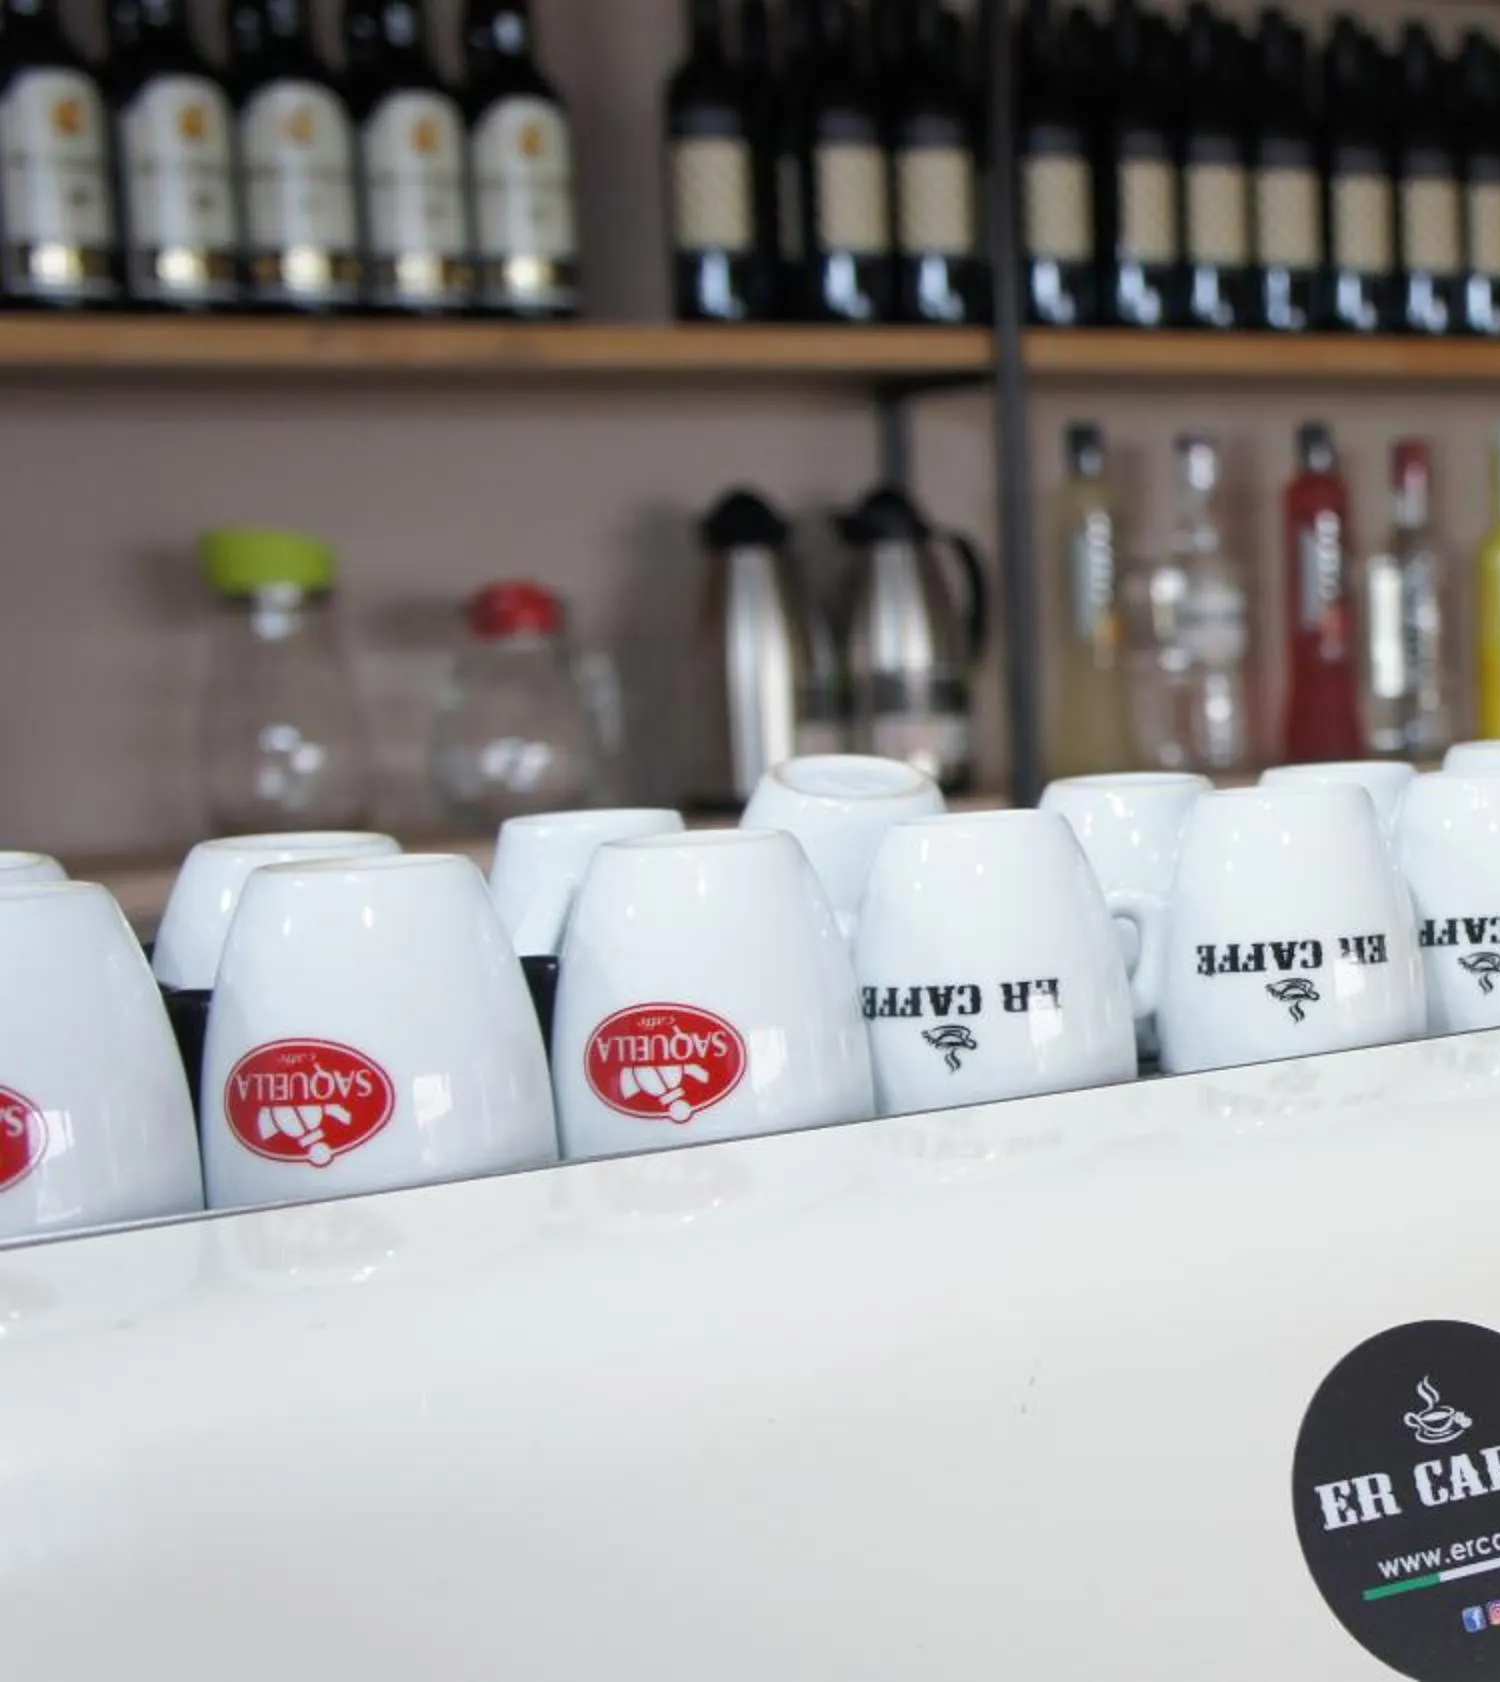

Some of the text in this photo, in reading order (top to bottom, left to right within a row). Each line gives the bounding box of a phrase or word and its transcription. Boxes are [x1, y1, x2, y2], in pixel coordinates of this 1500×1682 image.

[597, 1025, 729, 1063] SAQUELLA
[236, 1062, 373, 1101] SAQUELLA
[1314, 1472, 1402, 1530] ER
